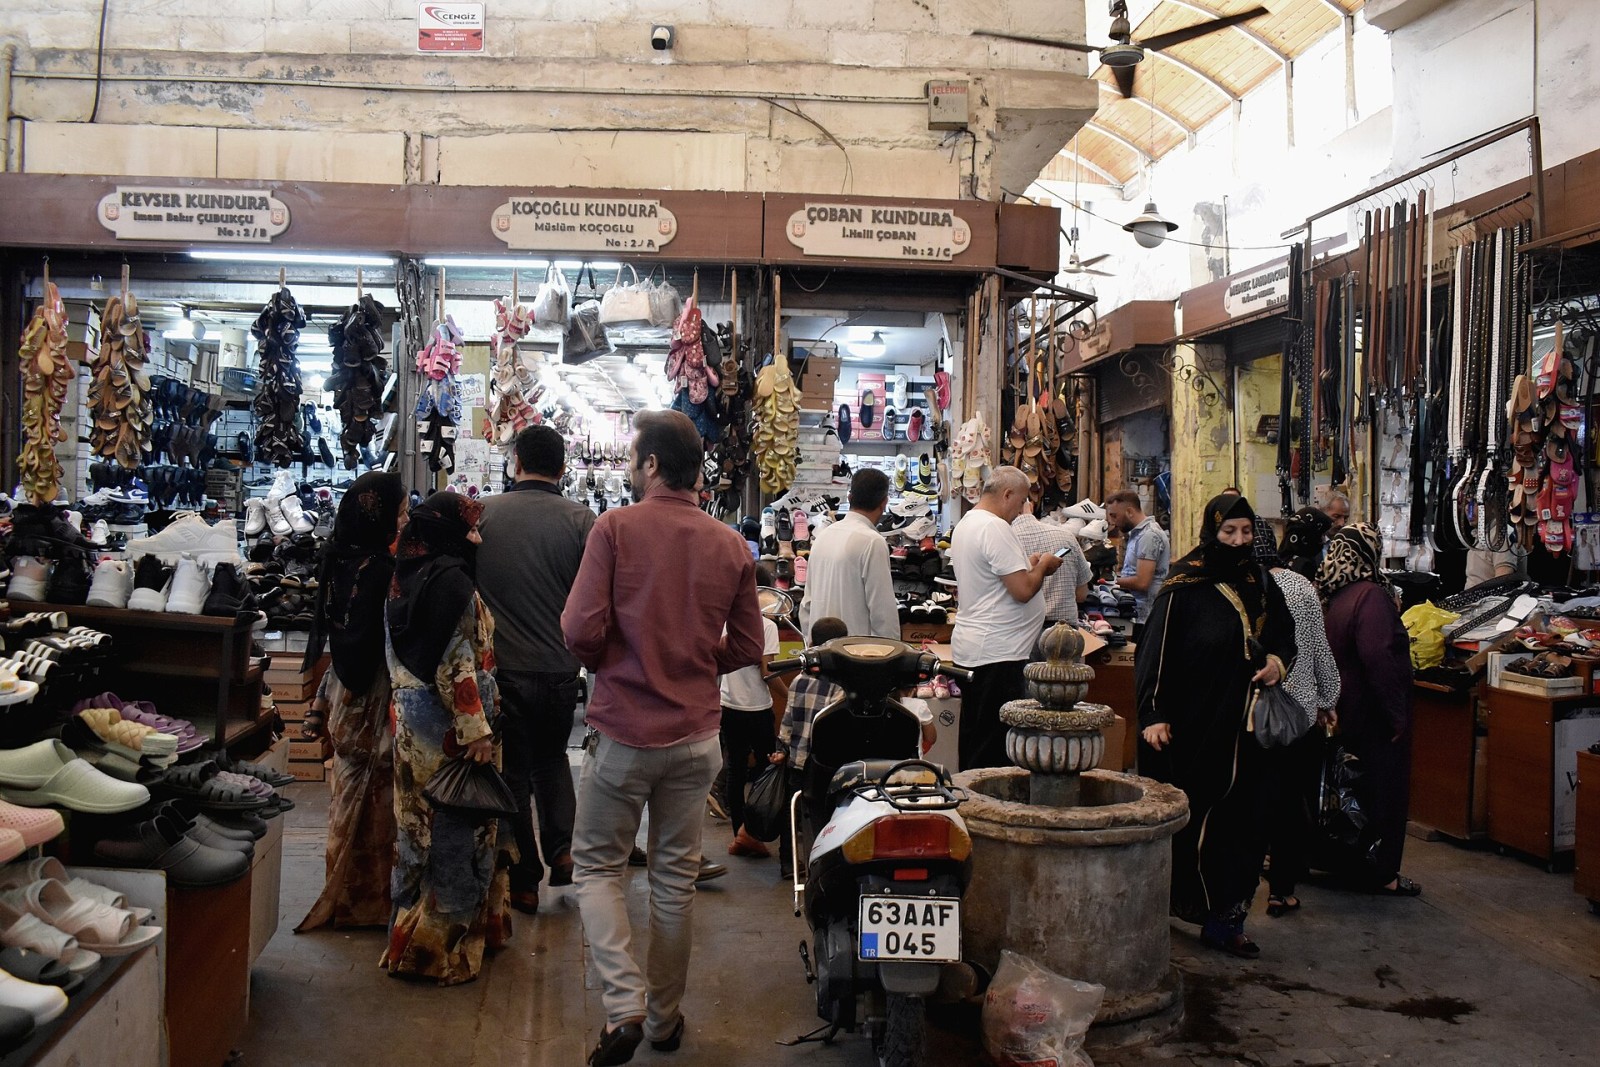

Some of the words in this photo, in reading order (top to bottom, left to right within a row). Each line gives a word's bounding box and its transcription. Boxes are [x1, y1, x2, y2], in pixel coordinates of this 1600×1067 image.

[121, 191, 182, 208] KEVSER
[186, 194, 270, 211] KUNDURA
[512, 200, 580, 220] KOÇOĞLU
[584, 202, 658, 218] KUNDURA
[196, 213, 254, 226] ÇUBUKÇU
[806, 206, 862, 226] ÇOBAN
[871, 209, 953, 227] KUNDURA
[534, 222, 576, 232] Müslüm
[876, 230, 916, 242] ÇOBAN
[868, 902, 953, 926] 63AAF
[865, 948, 876, 956] TR
[886, 932, 936, 955] 045
